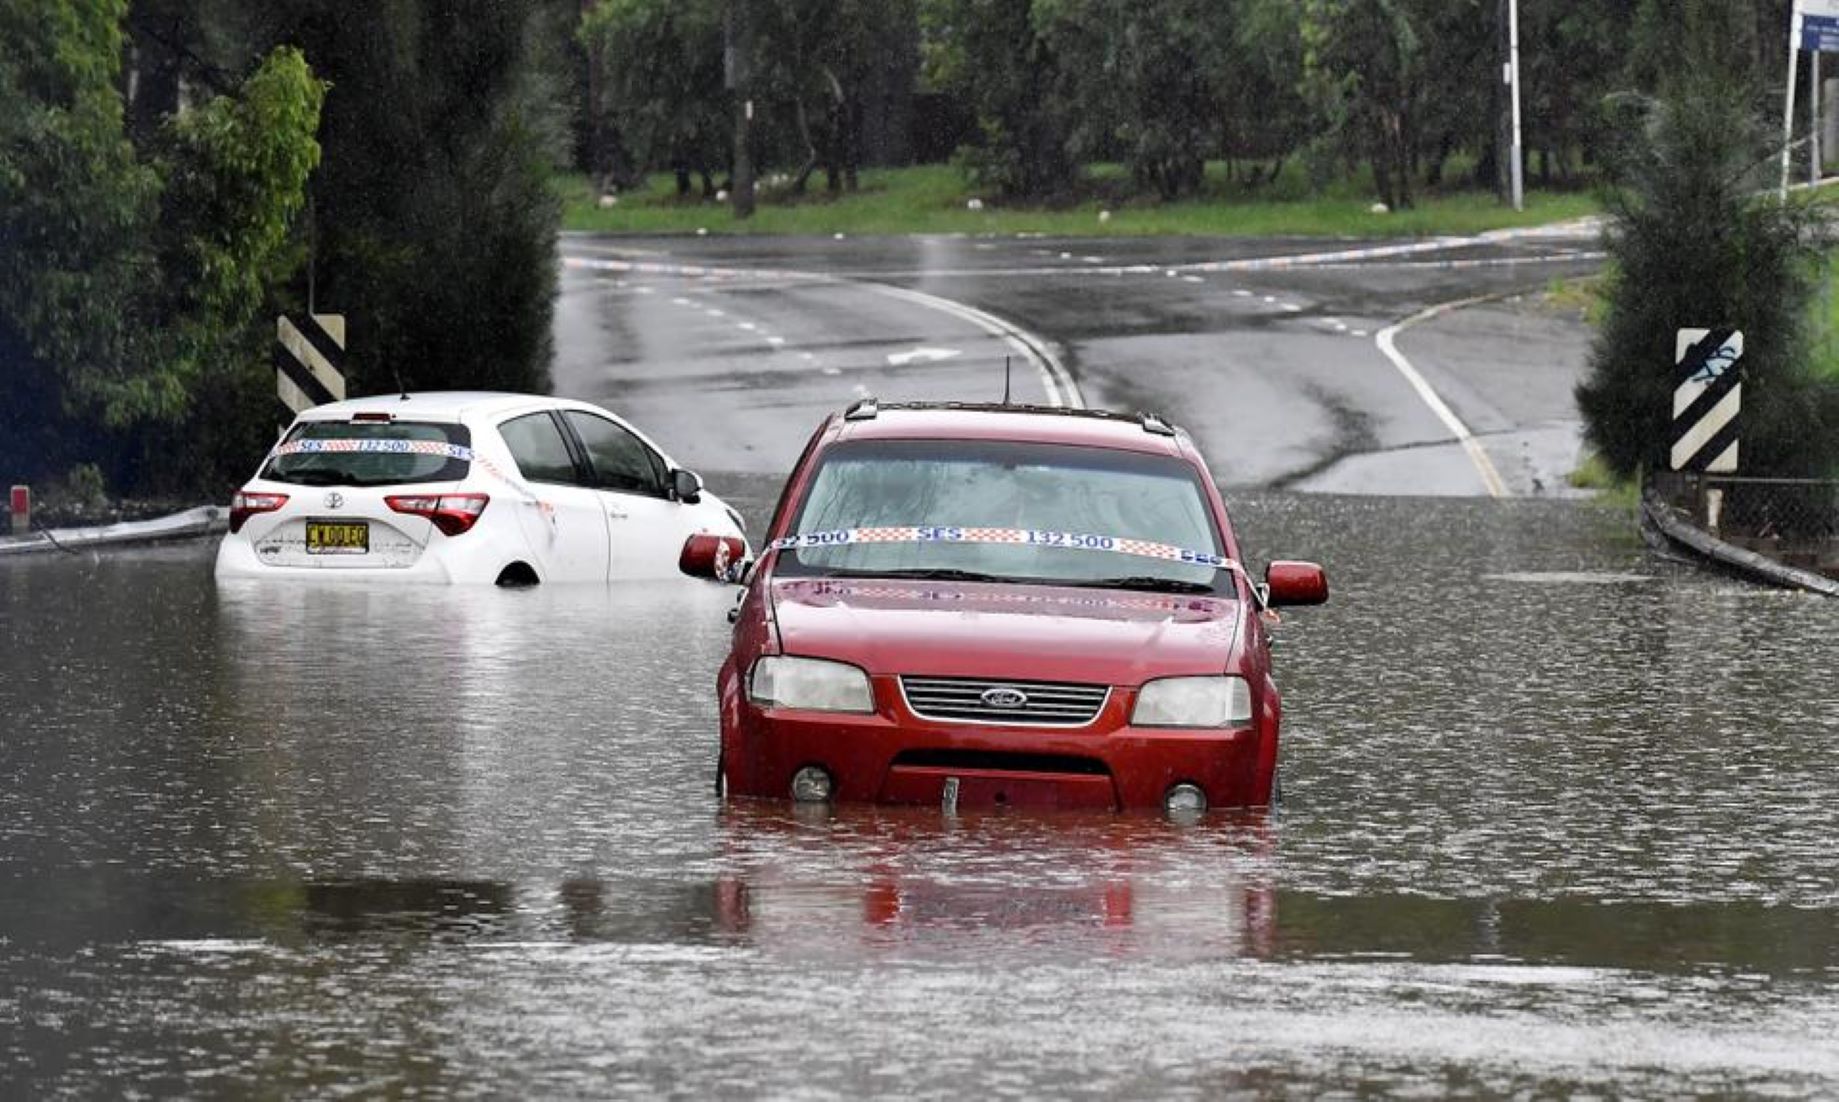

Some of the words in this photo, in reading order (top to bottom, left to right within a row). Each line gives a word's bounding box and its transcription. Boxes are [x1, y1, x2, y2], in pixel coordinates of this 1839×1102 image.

[301, 440, 323, 451] SES
[1028, 530, 1065, 546] 132
[1070, 533, 1114, 550] 500
